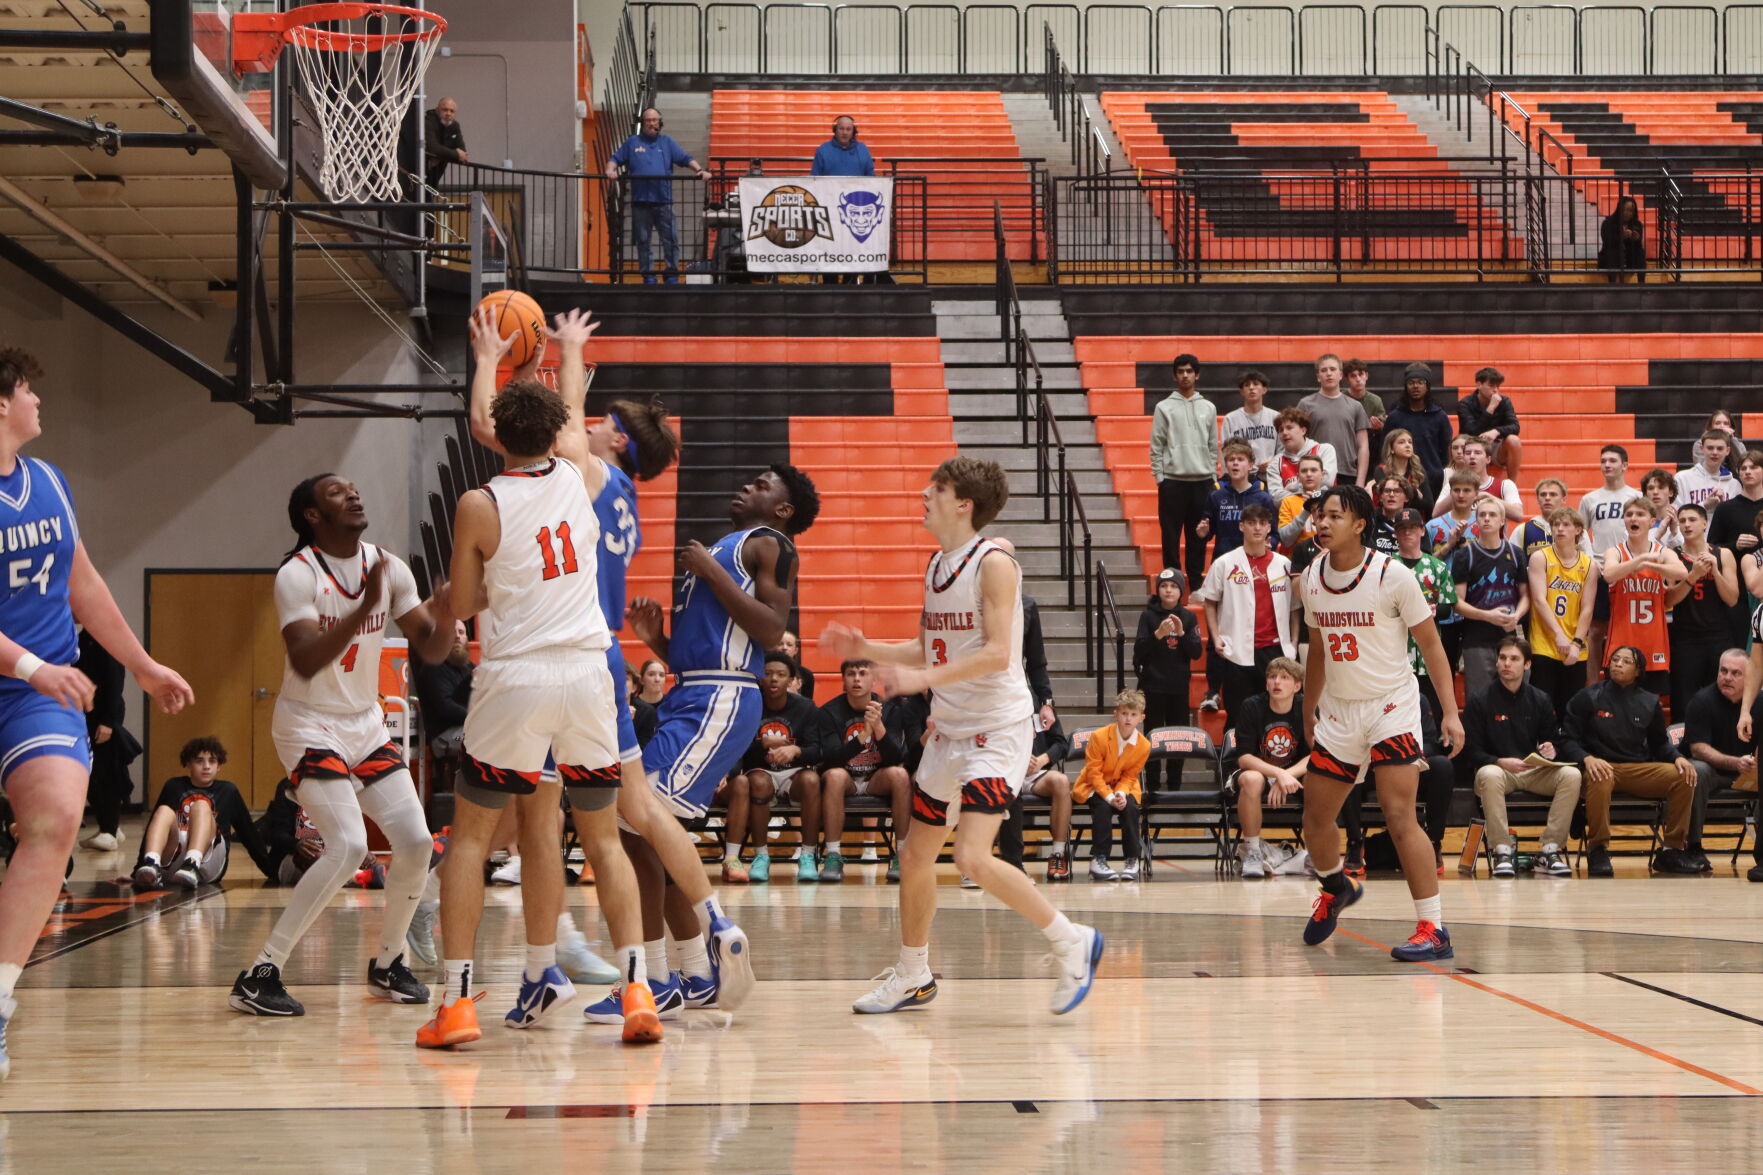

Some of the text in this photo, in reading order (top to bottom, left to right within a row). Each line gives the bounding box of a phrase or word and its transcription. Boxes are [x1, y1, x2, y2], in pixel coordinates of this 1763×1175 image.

[749, 206, 833, 239] SPORTS
[747, 252, 887, 265] meccasportsco.com
[536, 521, 578, 581] 11
[9, 553, 54, 596] 54
[1622, 577, 1661, 594] SYRACUSE
[1554, 595, 1567, 617] 6
[1693, 583, 1704, 600] 5
[1629, 599, 1654, 624] 15
[340, 643, 359, 673] 4
[931, 638, 948, 667] 3
[1327, 633, 1359, 662] 23
